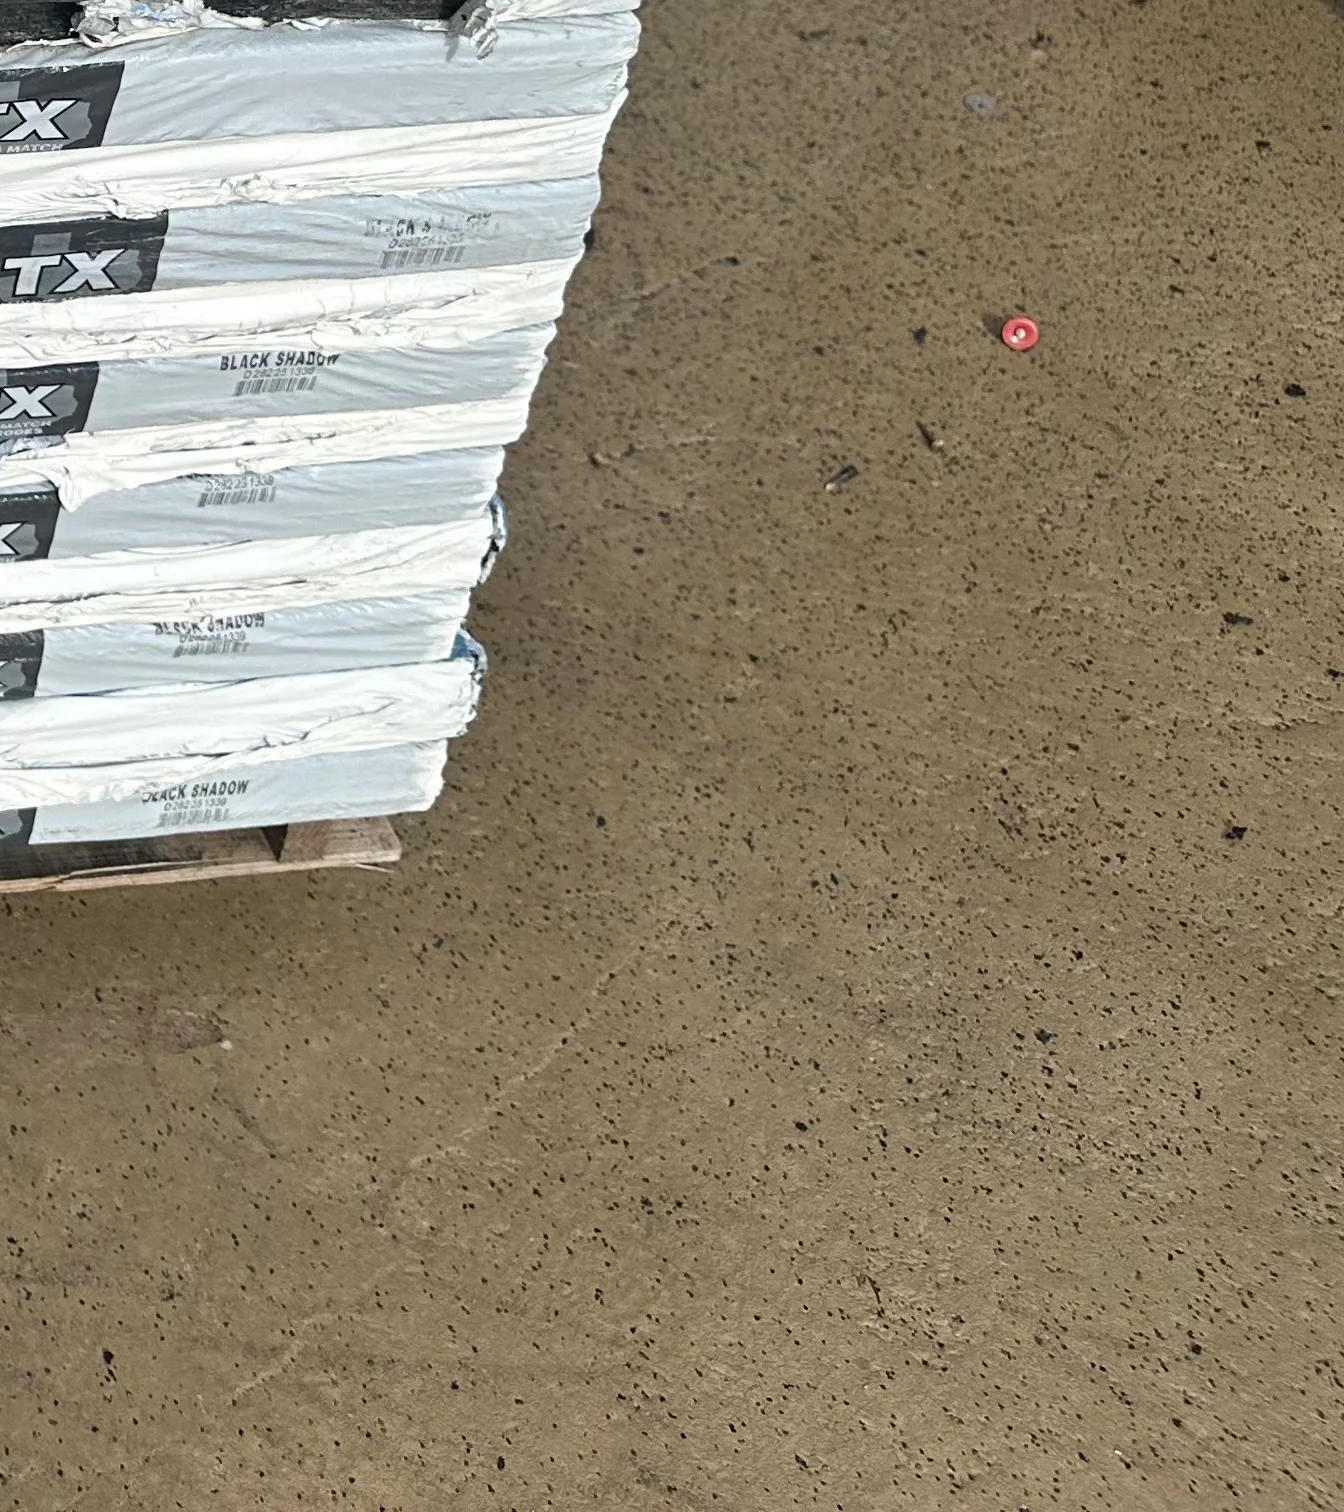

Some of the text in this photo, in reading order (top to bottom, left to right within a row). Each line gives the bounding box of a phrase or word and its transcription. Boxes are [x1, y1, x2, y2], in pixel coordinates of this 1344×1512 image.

[2, 248, 129, 298] TX
[220, 352, 270, 371] BLACK
[191, 780, 250, 799] SHADOW
